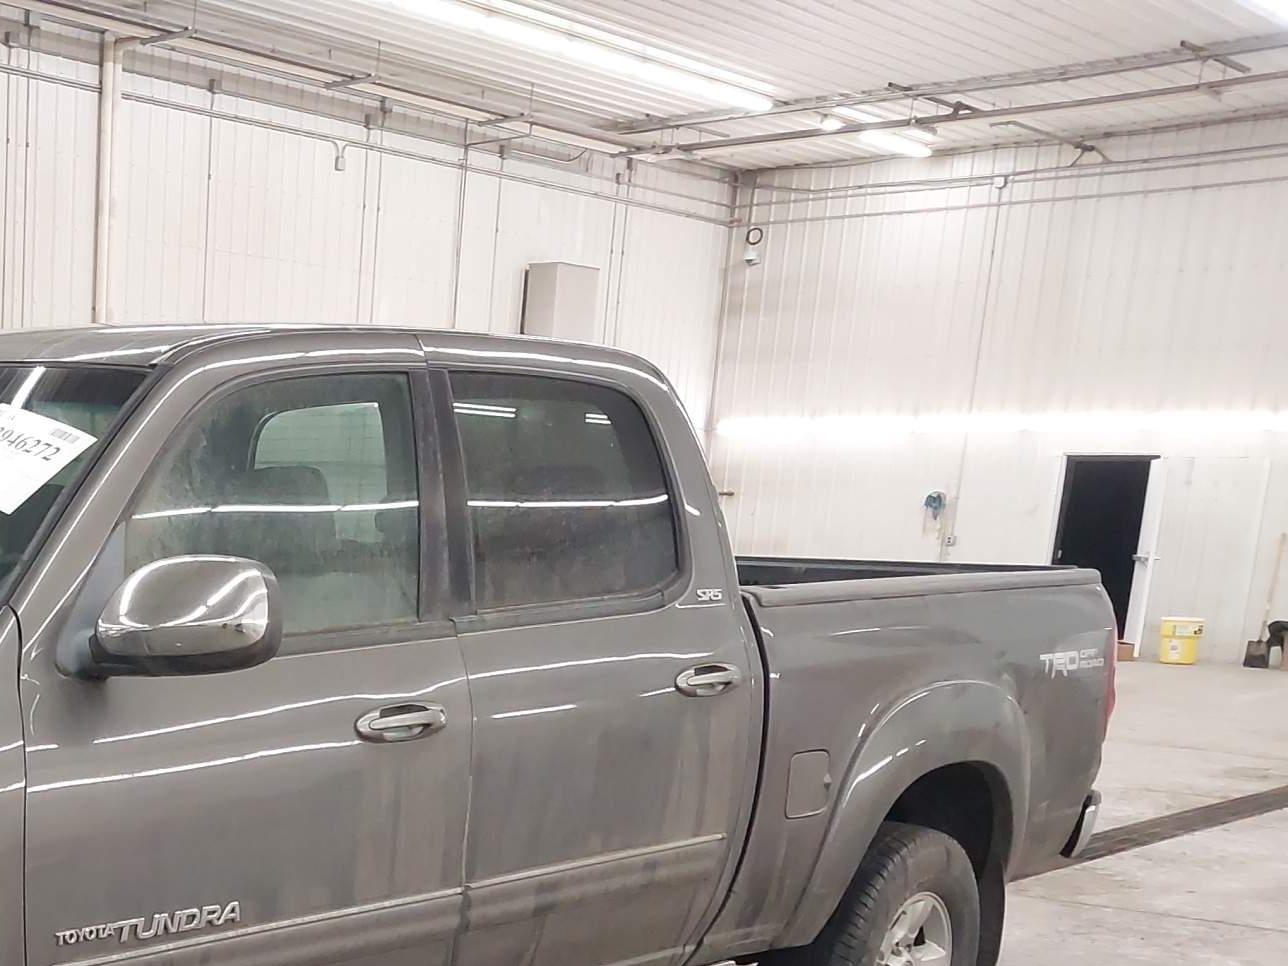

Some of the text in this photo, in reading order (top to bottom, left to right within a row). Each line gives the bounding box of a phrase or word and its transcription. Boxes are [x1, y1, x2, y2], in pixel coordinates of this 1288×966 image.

[1039, 650, 1079, 679] TRD
[56, 901, 241, 946] TOYOTA TUNDRA
